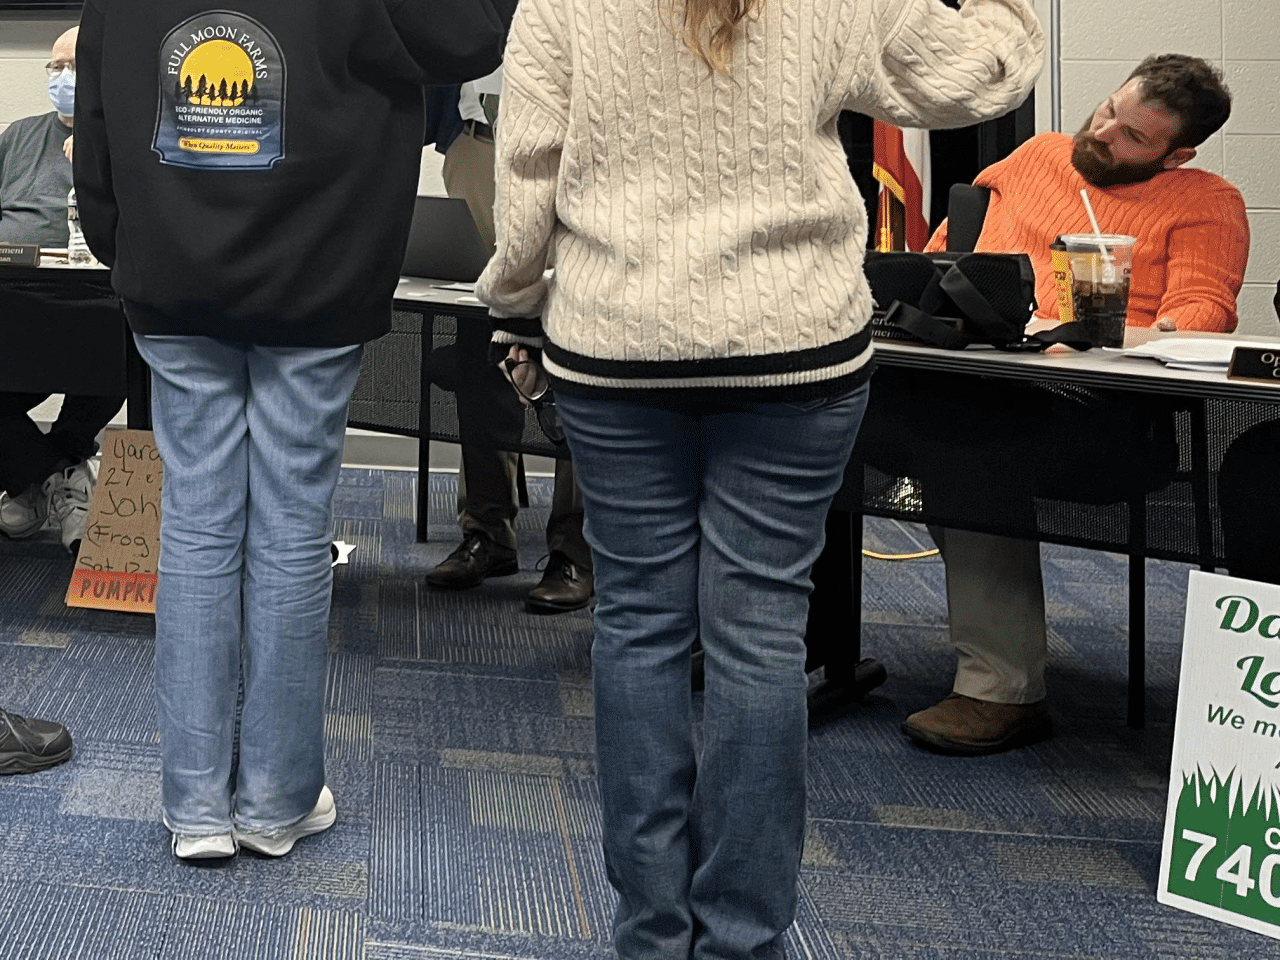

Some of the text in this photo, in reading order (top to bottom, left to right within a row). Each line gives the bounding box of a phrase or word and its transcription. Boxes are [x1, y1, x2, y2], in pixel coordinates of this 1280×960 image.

[167, 25, 268, 79] FULL MOON FARMS
[229, 108, 264, 116] ORGANIC
[198, 142, 223, 151] Quality
[100, 490, 160, 521] Joh
[80, 578, 157, 603] PUMPKI
[1215, 595, 1280, 640] Da
[1236, 655, 1280, 708] La
[1207, 703, 1245, 730] We
[1182, 828, 1280, 909] 740
